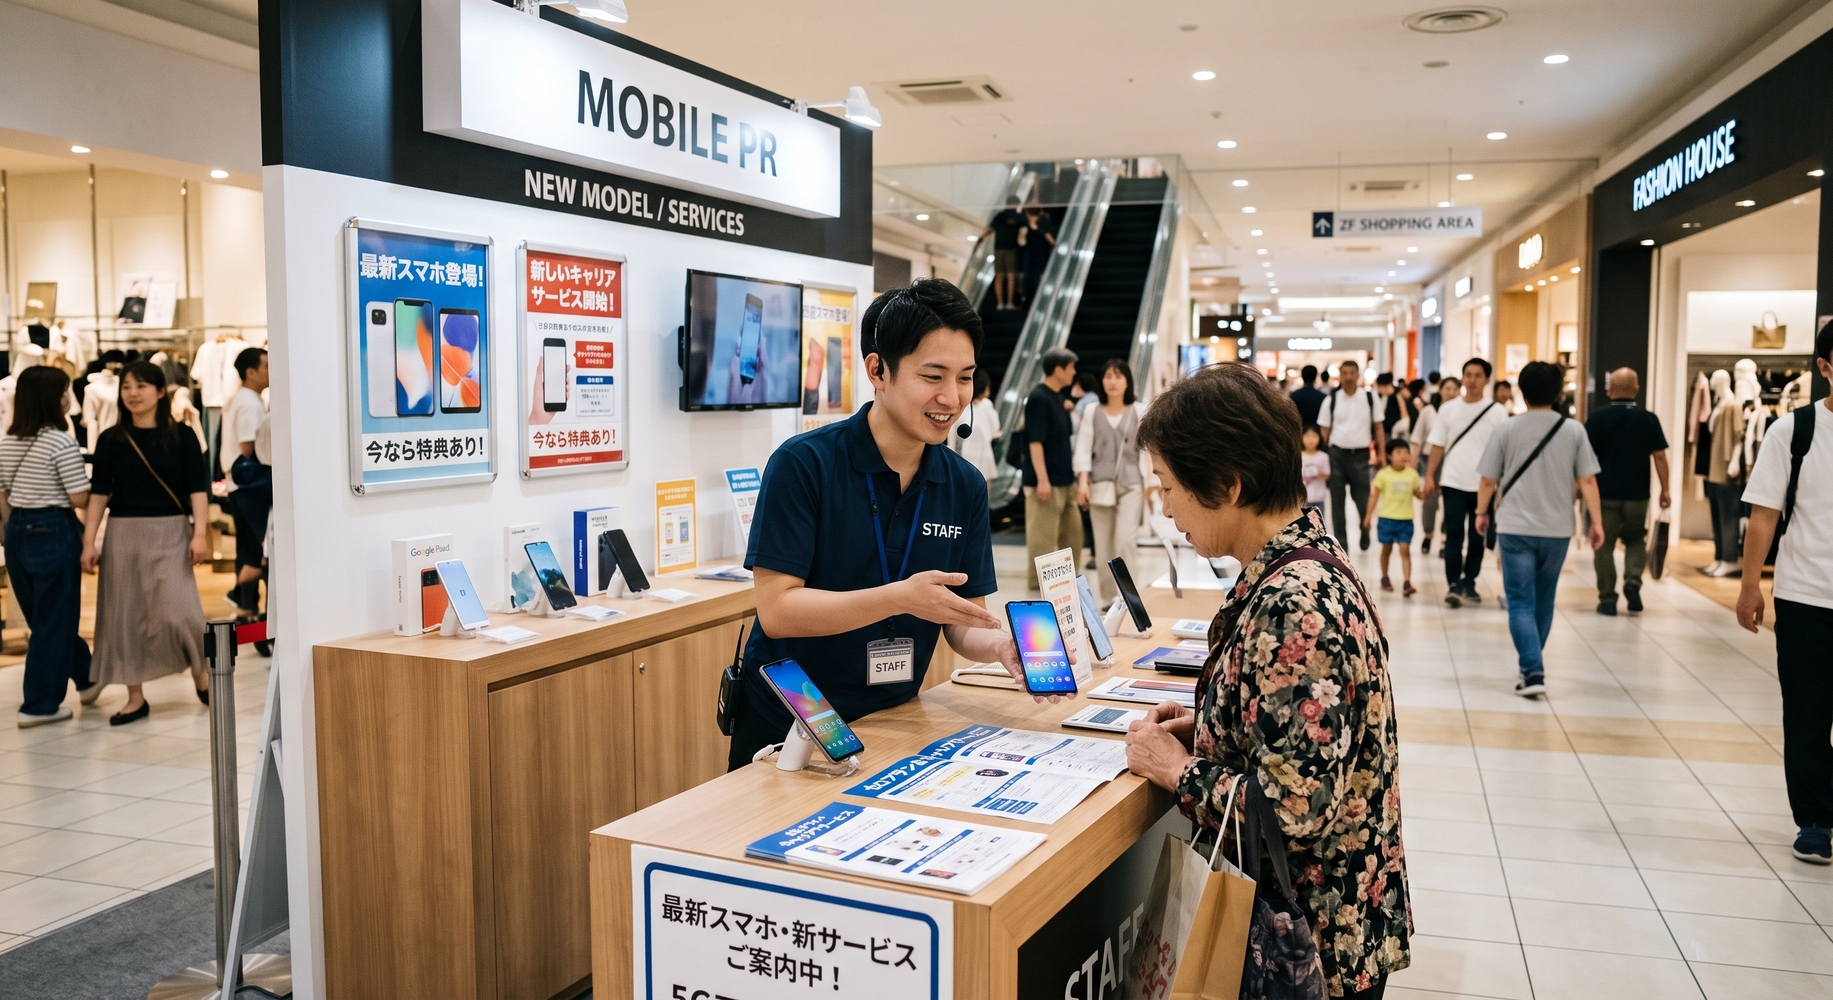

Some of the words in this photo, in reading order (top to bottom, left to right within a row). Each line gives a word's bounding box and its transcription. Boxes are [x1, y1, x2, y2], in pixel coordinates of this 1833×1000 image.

[577, 69, 728, 164] MOBILE
[739, 121, 777, 177] PR
[1633, 152, 1683, 212] FASHION
[1685, 119, 1736, 185] HOUSE
[524, 169, 577, 204] NEW
[582, 181, 653, 219] MODEL
[657, 197, 665, 221] /
[668, 199, 745, 236] SERVICES
[1360, 216, 1432, 231] SHOPPING
[1436, 216, 1474, 229] AREA
[360, 253, 484, 288] 最新スマホ登場!
[530, 259, 616, 288] 新しいキャリア
[531, 285, 614, 312] サービス開始!
[366, 436, 484, 464] 今なら特典あり!
[533, 429, 616, 449] 今なら特典あり!
[922, 523, 962, 539] STAFF
[410, 546, 435, 557] Google
[875, 660, 906, 673] STAFF
